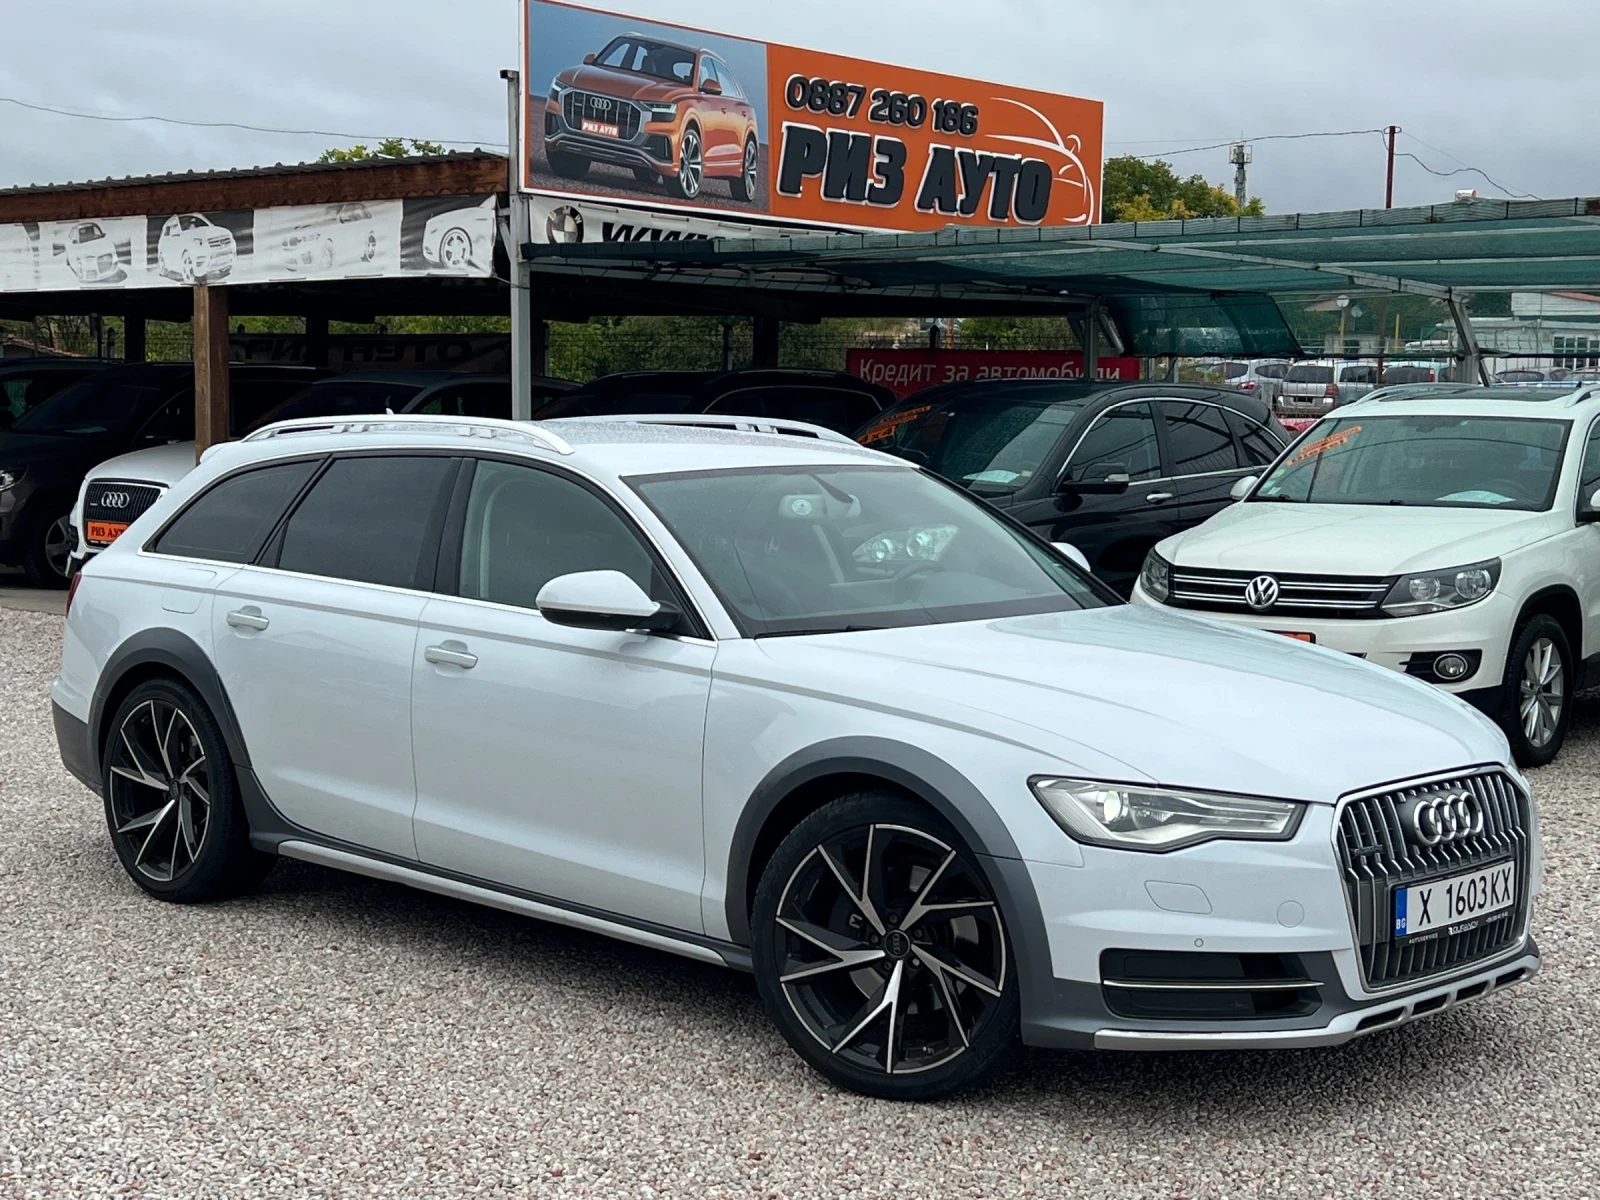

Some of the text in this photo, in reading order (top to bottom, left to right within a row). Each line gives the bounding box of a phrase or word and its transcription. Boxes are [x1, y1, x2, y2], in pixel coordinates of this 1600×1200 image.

[785, 74, 979, 137] 0887 260 186
[583, 122, 617, 135] РИЗ АУТО
[776, 120, 1053, 225] РИЗ АУТО
[859, 359, 937, 387] Кредит
[942, 365, 970, 383] за
[91, 526, 125, 538] РИЗ АУТ
[1418, 888, 1432, 926] X
[1396, 917, 1407, 930] BG
